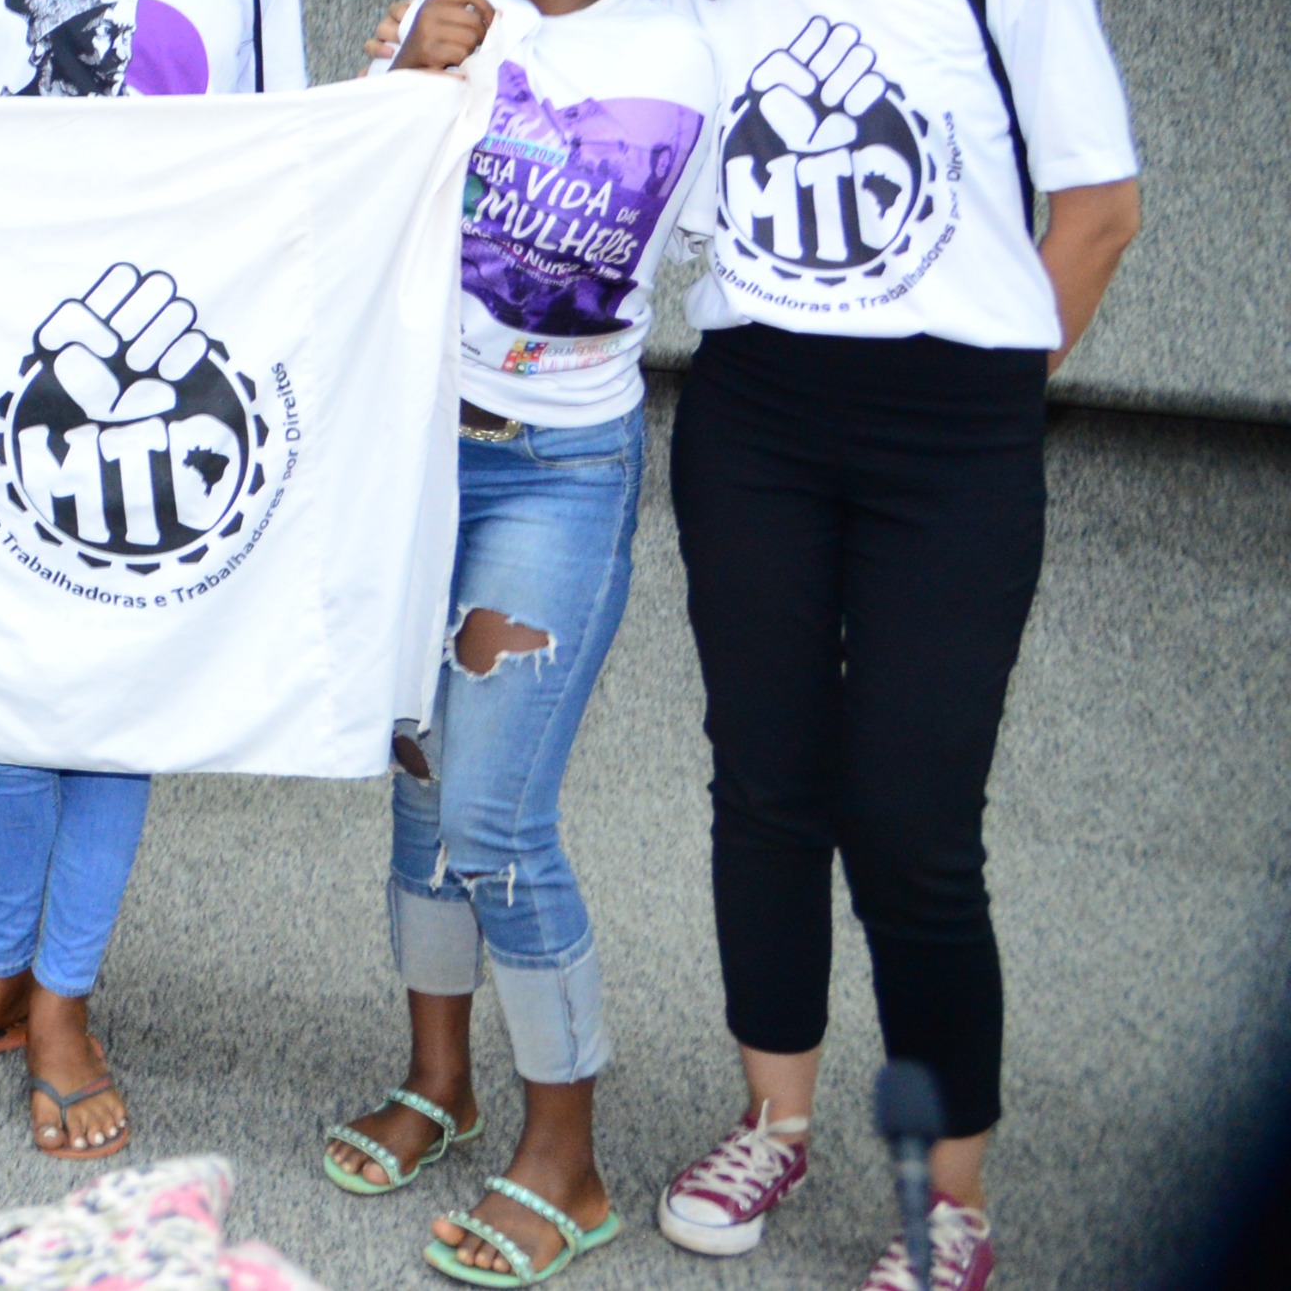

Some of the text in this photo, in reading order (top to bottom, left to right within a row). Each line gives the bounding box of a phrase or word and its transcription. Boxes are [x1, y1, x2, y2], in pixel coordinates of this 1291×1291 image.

[473, 185, 638, 265] MULHERES
[526, 164, 613, 217] VIDA
[725, 143, 913, 263] MTD
[839, 301, 849, 311] e
[856, 224, 955, 310] Trabalhadores
[942, 111, 963, 181] Direitos
[271, 361, 301, 442] Direitos
[18, 413, 241, 546] MTD
[281, 446, 300, 481] por
[1, 530, 147, 609] Trabalhadoras
[171, 486, 286, 604] Trabalhadores
[155, 593, 167, 607] e
